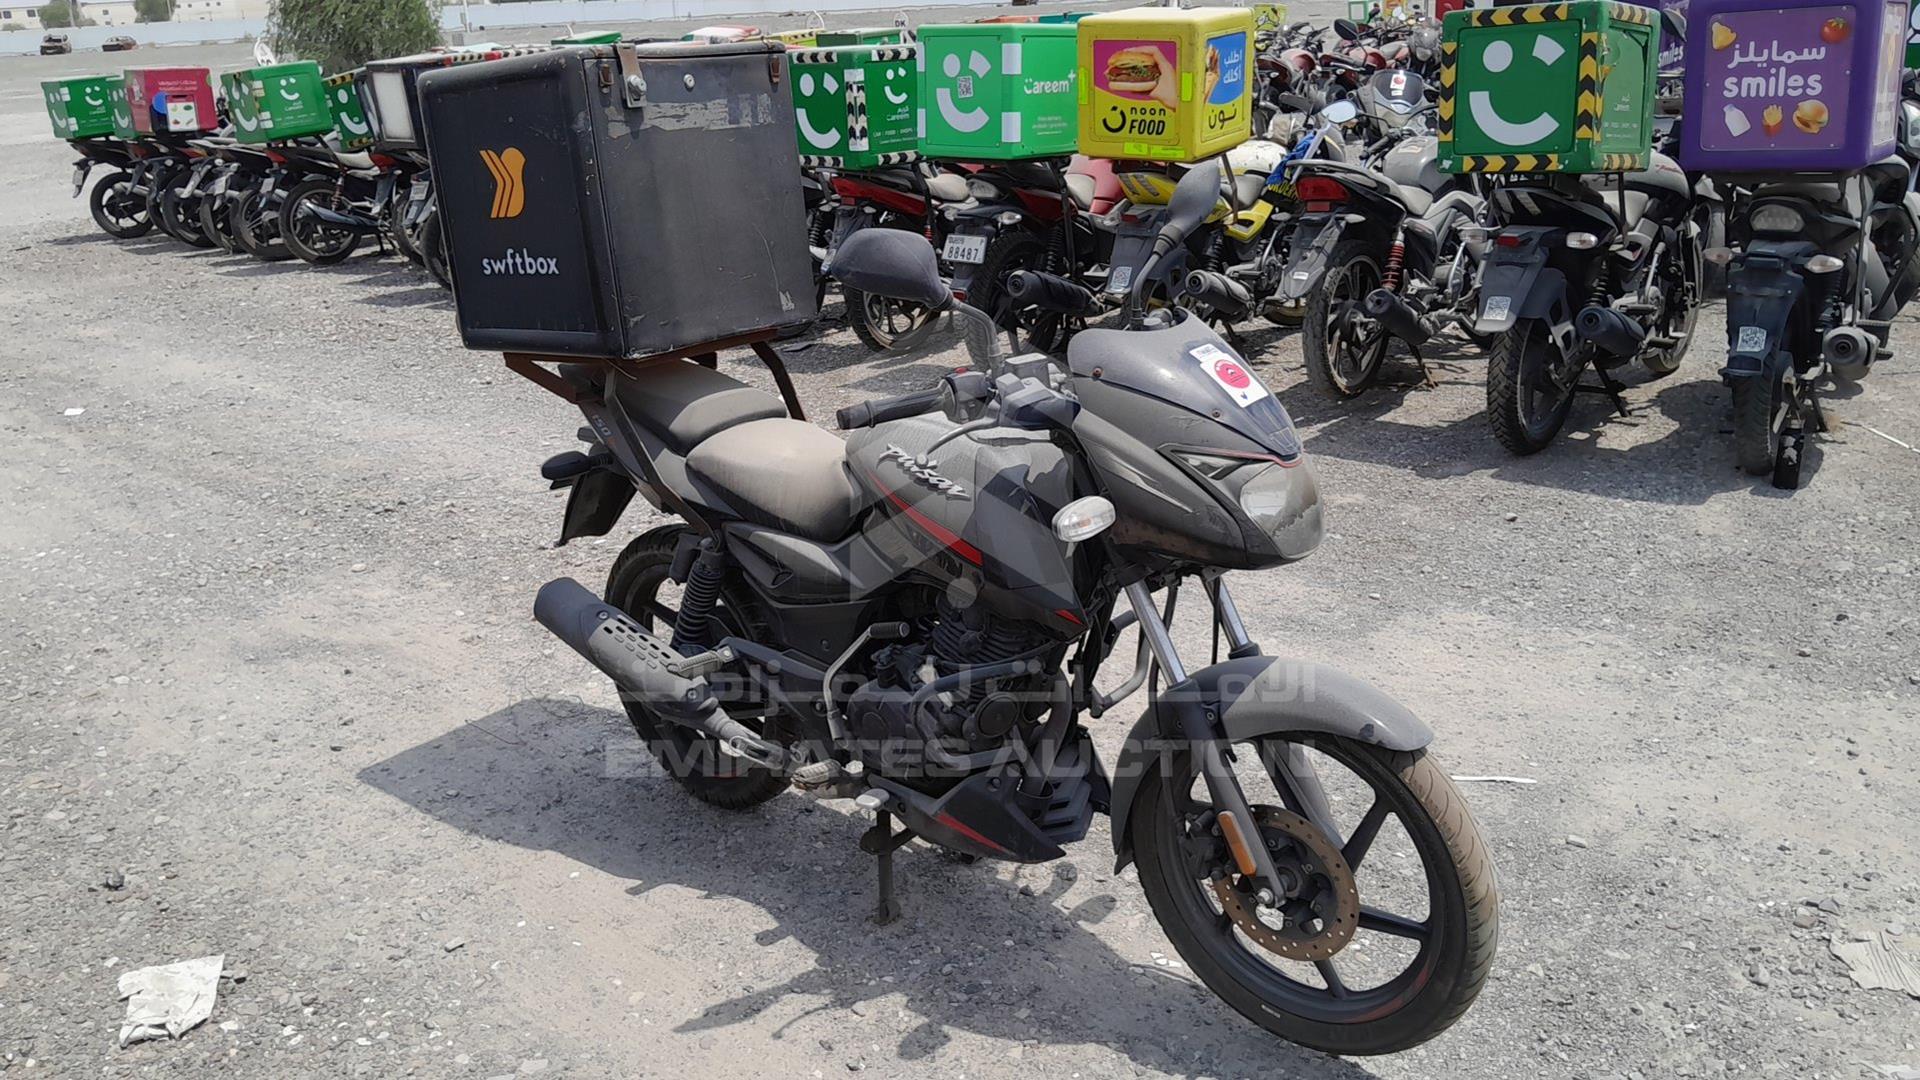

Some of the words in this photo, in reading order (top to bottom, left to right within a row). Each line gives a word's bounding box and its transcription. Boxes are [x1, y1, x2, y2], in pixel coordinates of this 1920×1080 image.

[1658, 42, 1684, 69] smiles
[1727, 40, 1826, 69] سمايلز
[1722, 66, 1823, 98] smiles
[1130, 107, 1166, 116] noon
[1129, 119, 1165, 136] FOOD
[482, 247, 560, 275] swftbox
[948, 246, 978, 261] 88487
